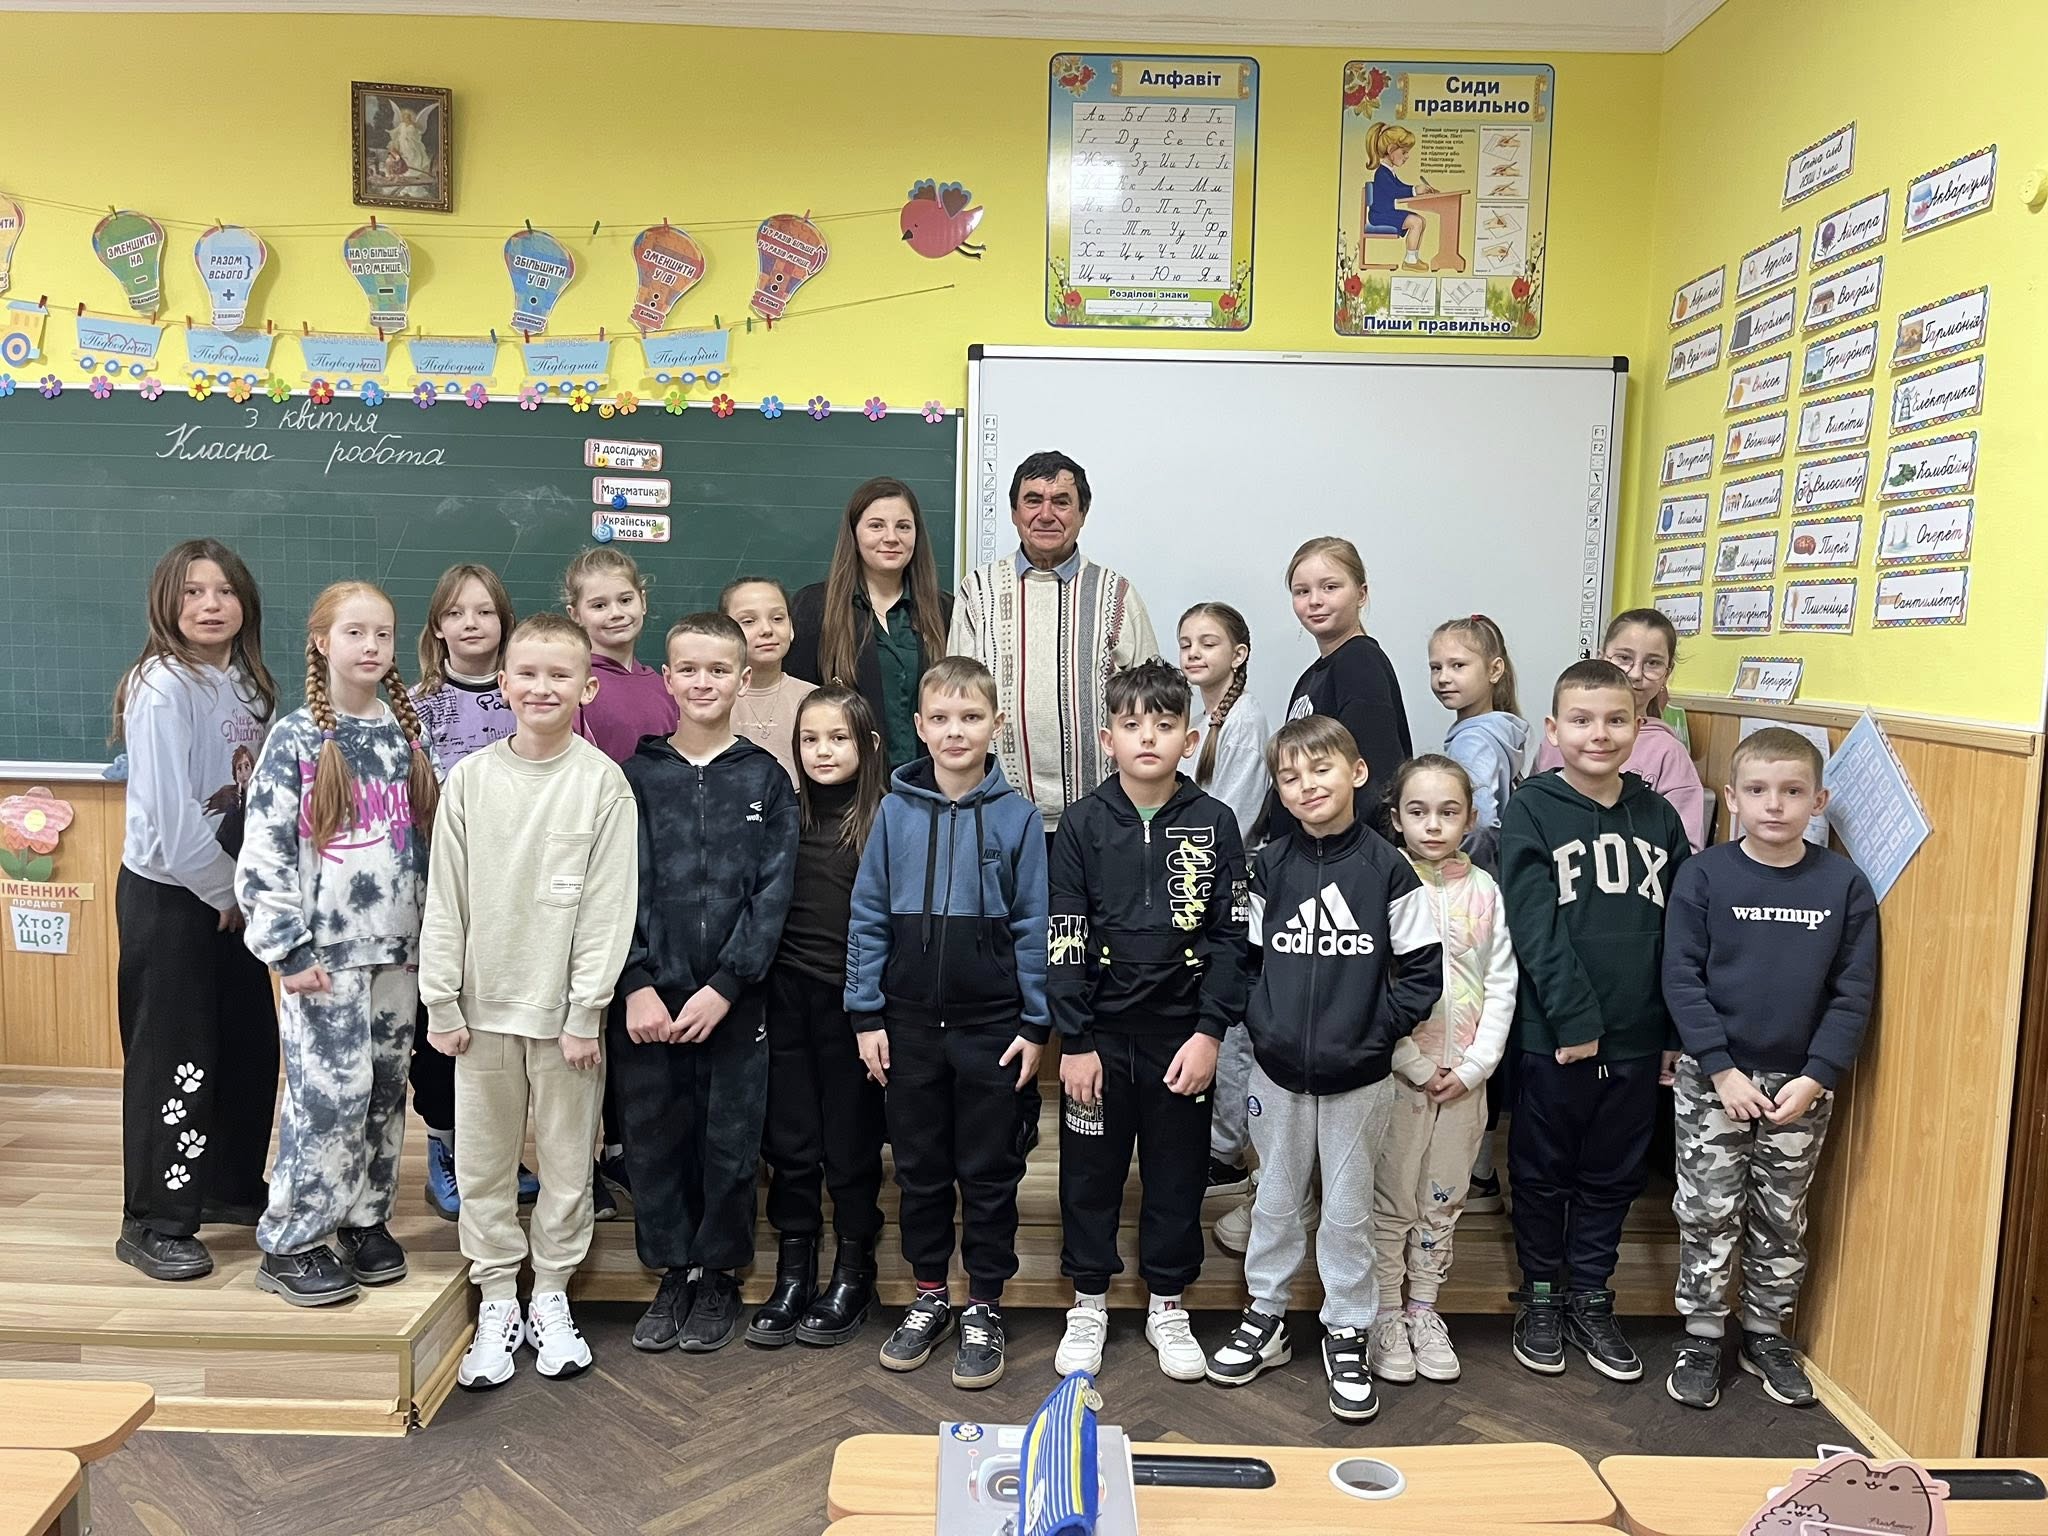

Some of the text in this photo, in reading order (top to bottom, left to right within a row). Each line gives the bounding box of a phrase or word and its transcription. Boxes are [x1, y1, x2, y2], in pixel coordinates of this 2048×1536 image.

[1140, 70, 1221, 89] Алфавіт
[1446, 76, 1500, 94] Сиди
[1414, 98, 1530, 116] правильно
[107, 234, 156, 258] ЗМЕНШИТИ
[350, 250, 360, 258] НА
[371, 249, 398, 258] БІЛЬШЕ
[130, 254, 143, 266] НА
[211, 256, 242, 265] РАЗОМ
[515, 256, 566, 277] ЗБІЛЬШИТИ
[644, 250, 695, 277] ЗМЕНШИТИ
[209, 270, 243, 279] ВСЬОГО
[352, 265, 363, 274] НА
[373, 263, 401, 273] МЕНШЕ
[654, 270, 662, 279] У
[528, 274, 534, 284] У
[1109, 289, 1189, 299] Розділові знаки
[1364, 317, 1511, 334] Пиши правильно
[83, 333, 149, 354] Підводний
[194, 345, 262, 364] Підводний
[653, 350, 719, 367] Підводний
[311, 353, 377, 373] Підводний
[419, 357, 487, 374] Підводний
[533, 360, 599, 375] Підводний
[245, 399, 379, 434] 3 квітня
[985, 433, 995, 441] F2
[156, 423, 446, 475] Класна робота
[593, 443, 657, 456] Я досліджую
[1593, 443, 1604, 451] F2
[615, 457, 634, 466] світ
[601, 485, 659, 497] Математика
[602, 515, 657, 528] Українська
[618, 529, 644, 538] мова
[1553, 833, 1668, 908] FOX
[1, 883, 80, 898] ІМЕННИК
[12, 898, 64, 909] предмет
[17, 914, 64, 930] Хто?
[1732, 905, 1831, 930] warmup
[20, 930, 64, 947] Що?
[1271, 926, 1375, 956] adidas
